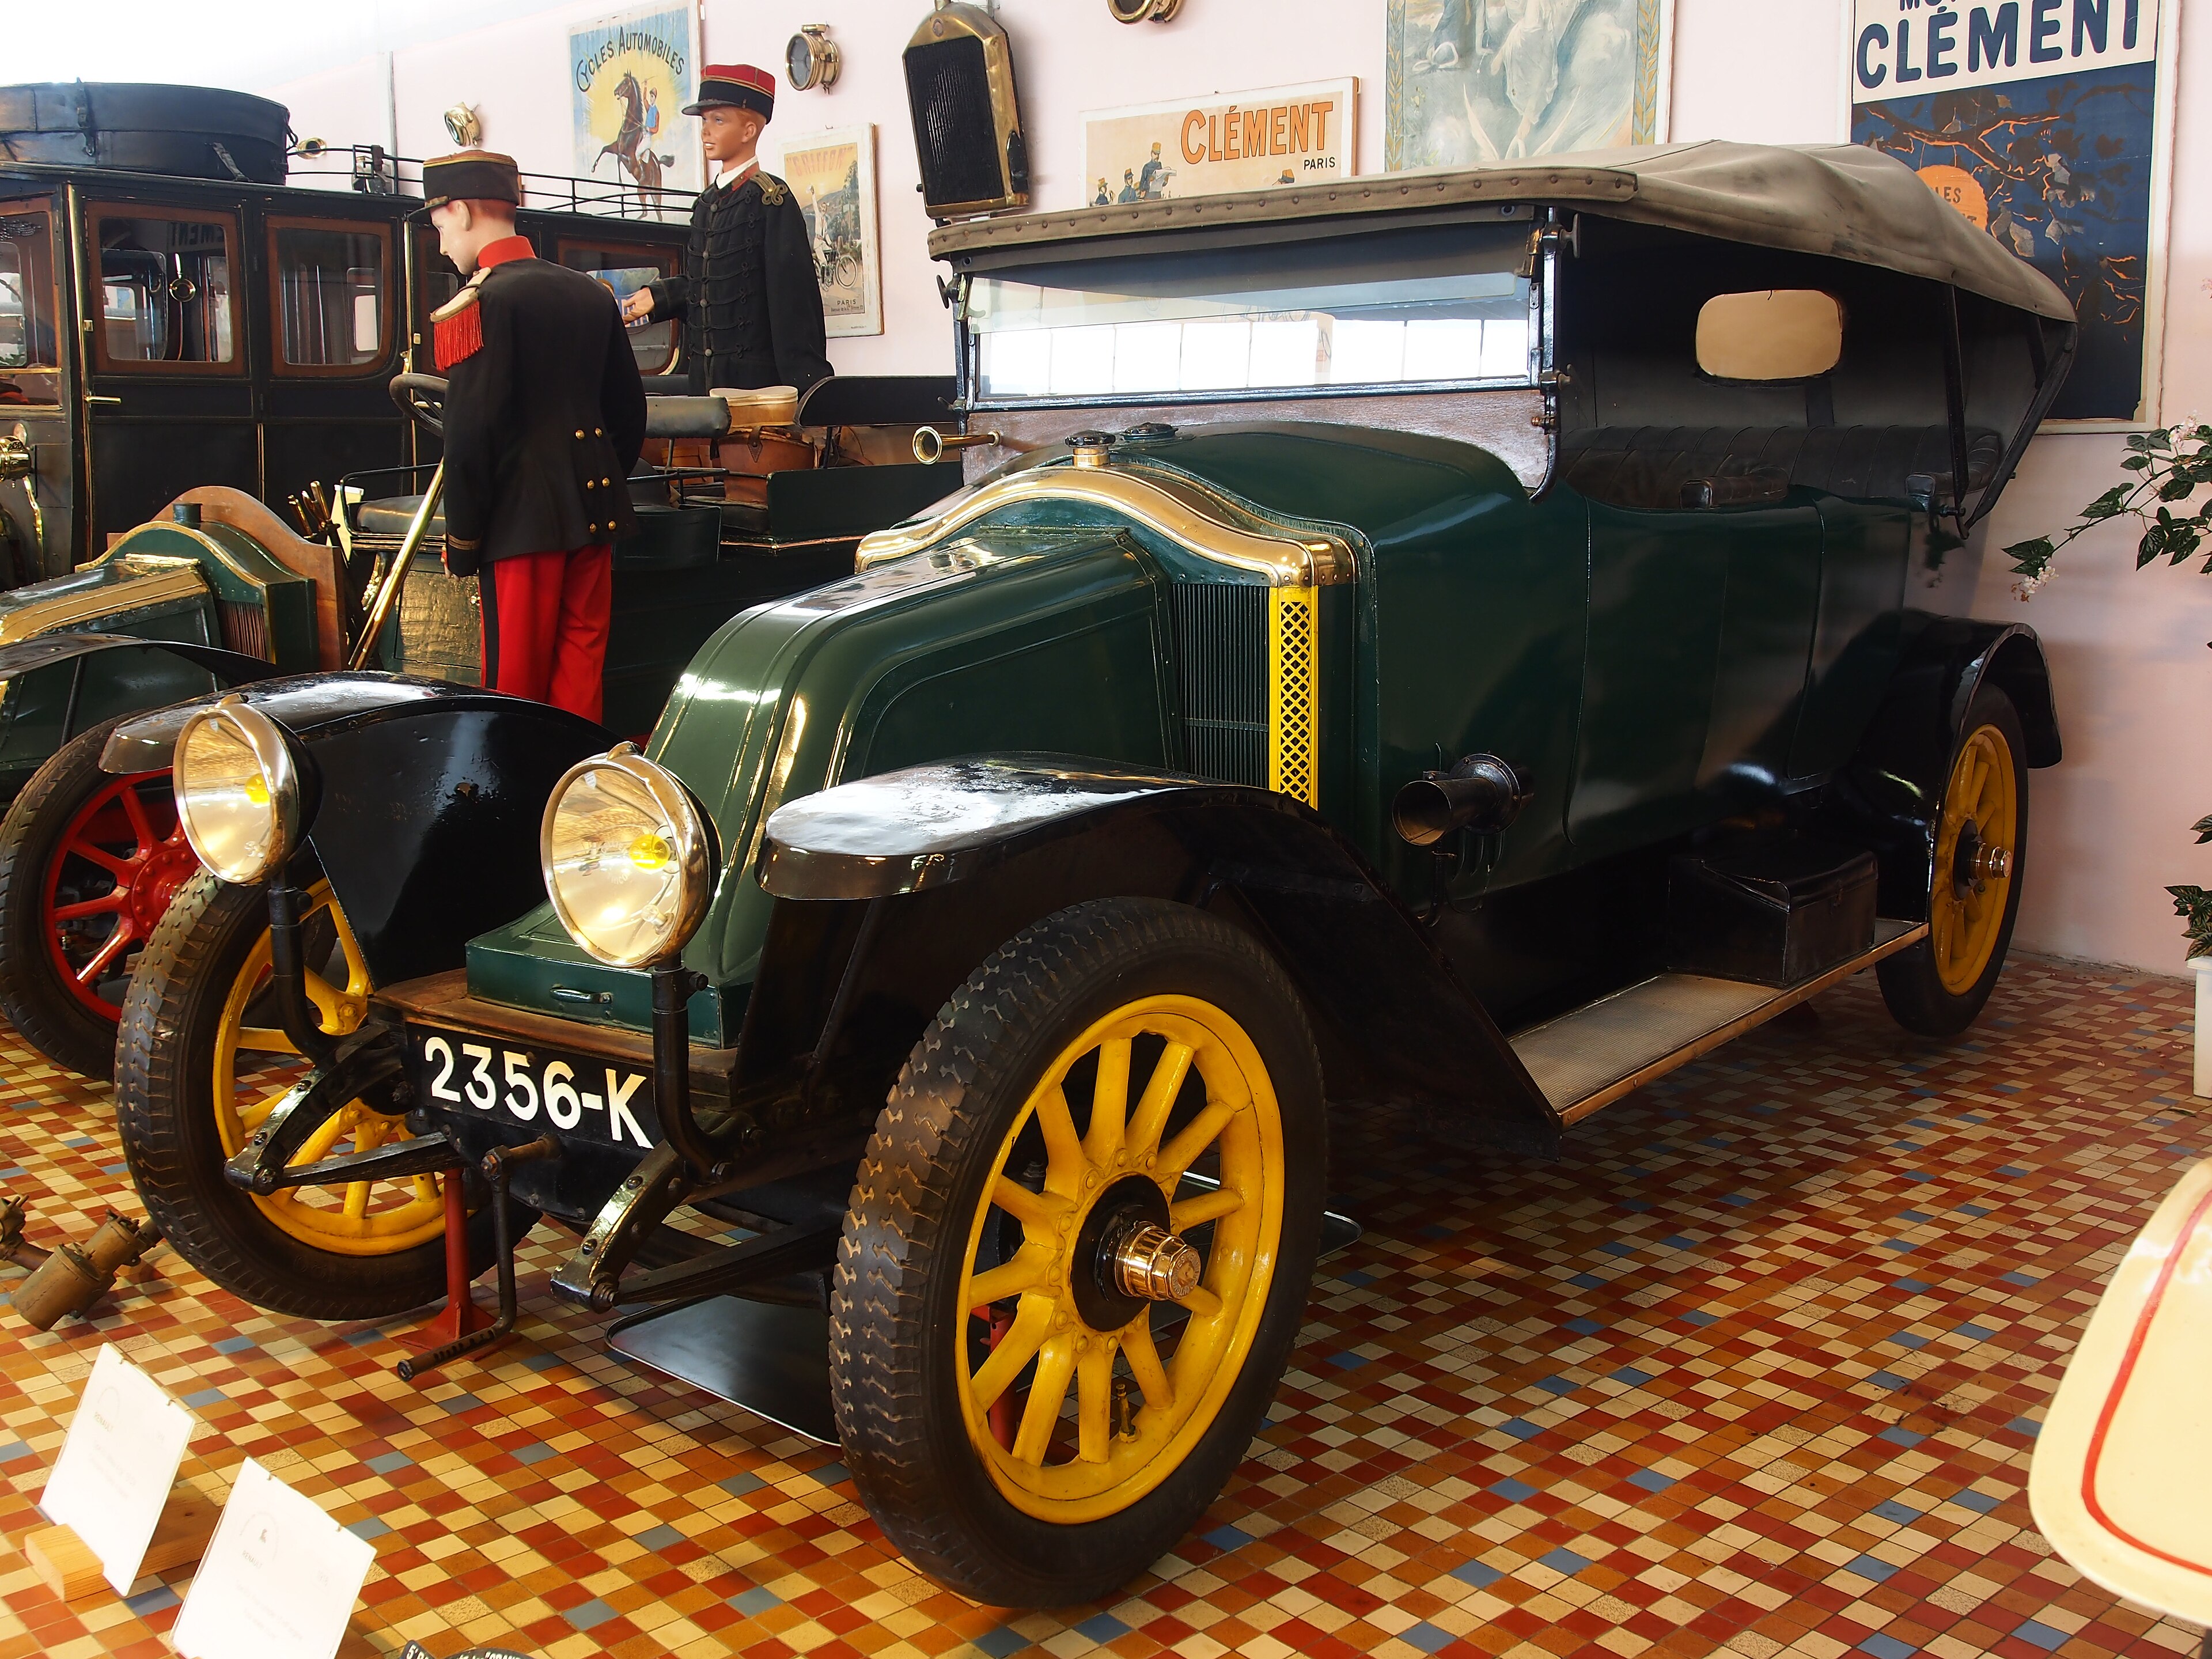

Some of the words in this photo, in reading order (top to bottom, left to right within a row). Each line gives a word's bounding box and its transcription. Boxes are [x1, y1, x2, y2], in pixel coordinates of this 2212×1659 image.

[576, 40, 614, 92] CYCLES
[619, 26, 684, 75] AUTOMOBILES
[1181, 101, 1334, 165] CLÉMENT
[1304, 157, 1336, 171] PARIS
[424, 1037, 653, 1149] 2356-K
[93, 1411, 115, 1433] RENAULT
[241, 1550, 263, 1569] RENAULT
